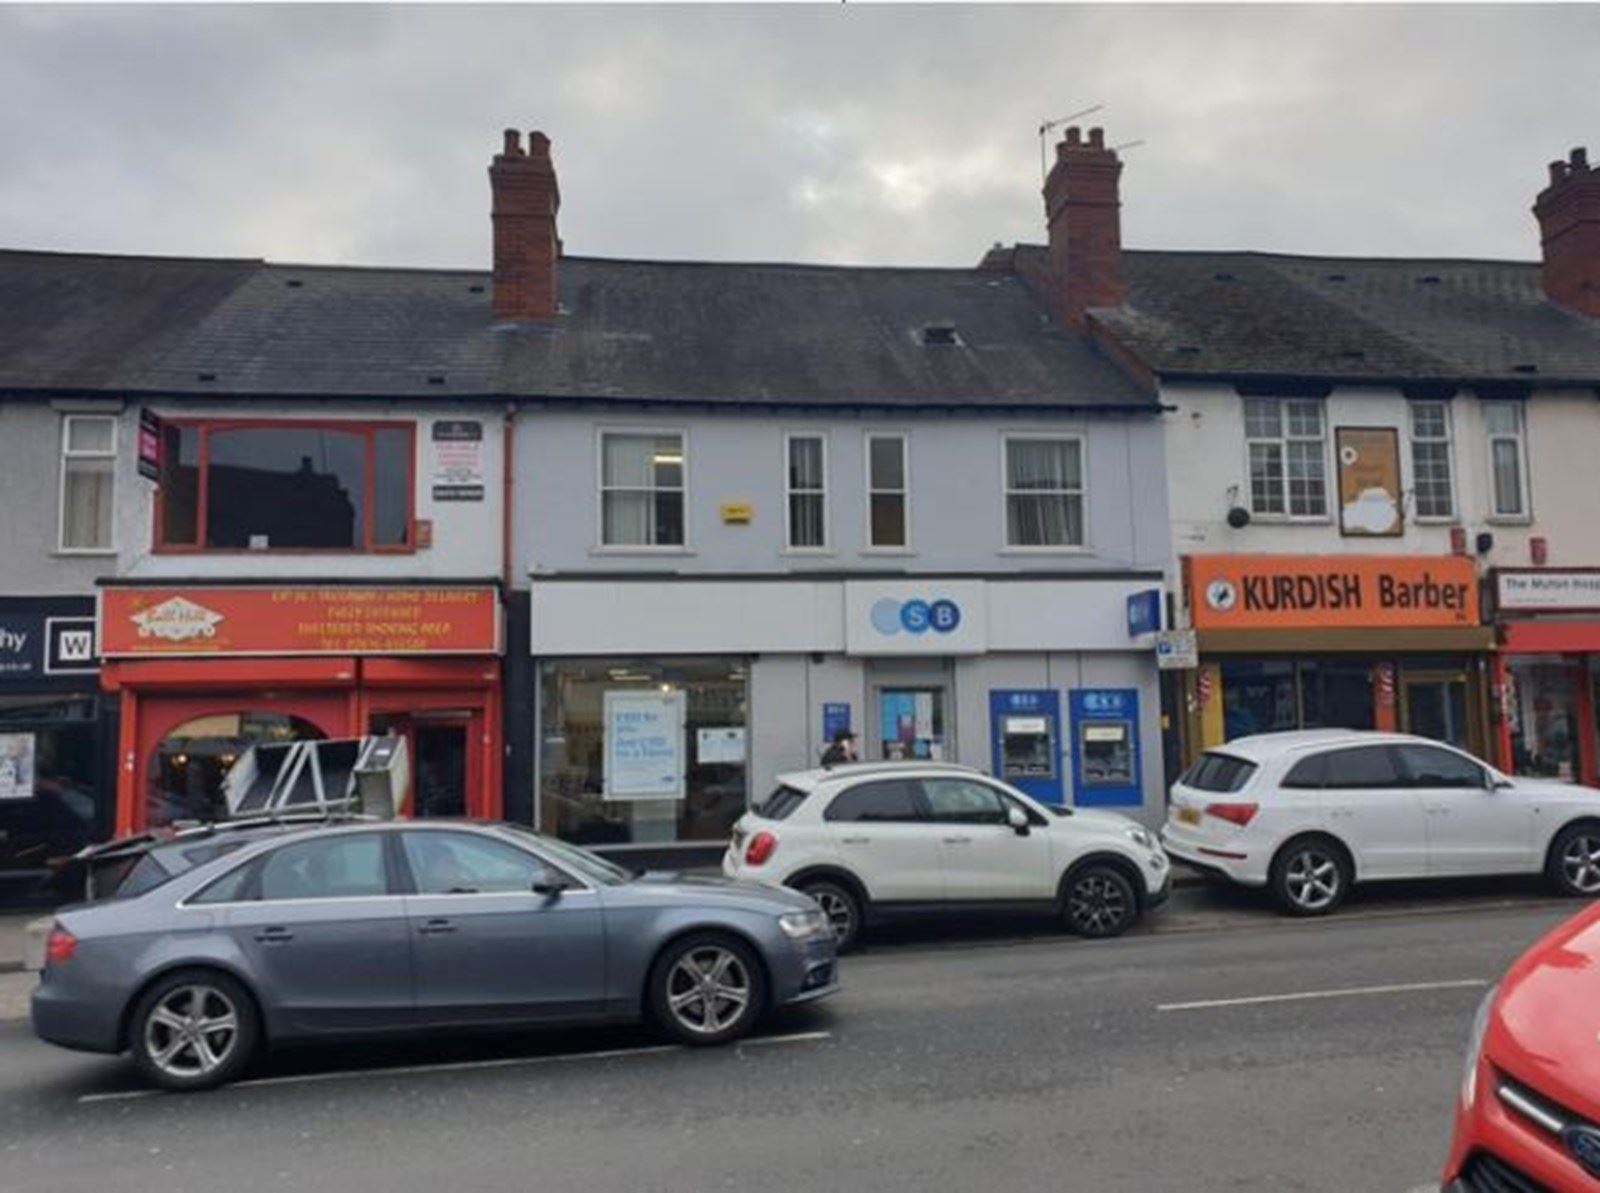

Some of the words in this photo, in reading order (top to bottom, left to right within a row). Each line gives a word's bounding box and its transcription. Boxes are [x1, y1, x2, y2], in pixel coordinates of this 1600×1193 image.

[1243, 574, 1362, 611] KURDISH
[1380, 573, 1469, 610] Barber
[64, 636, 88, 656] W
